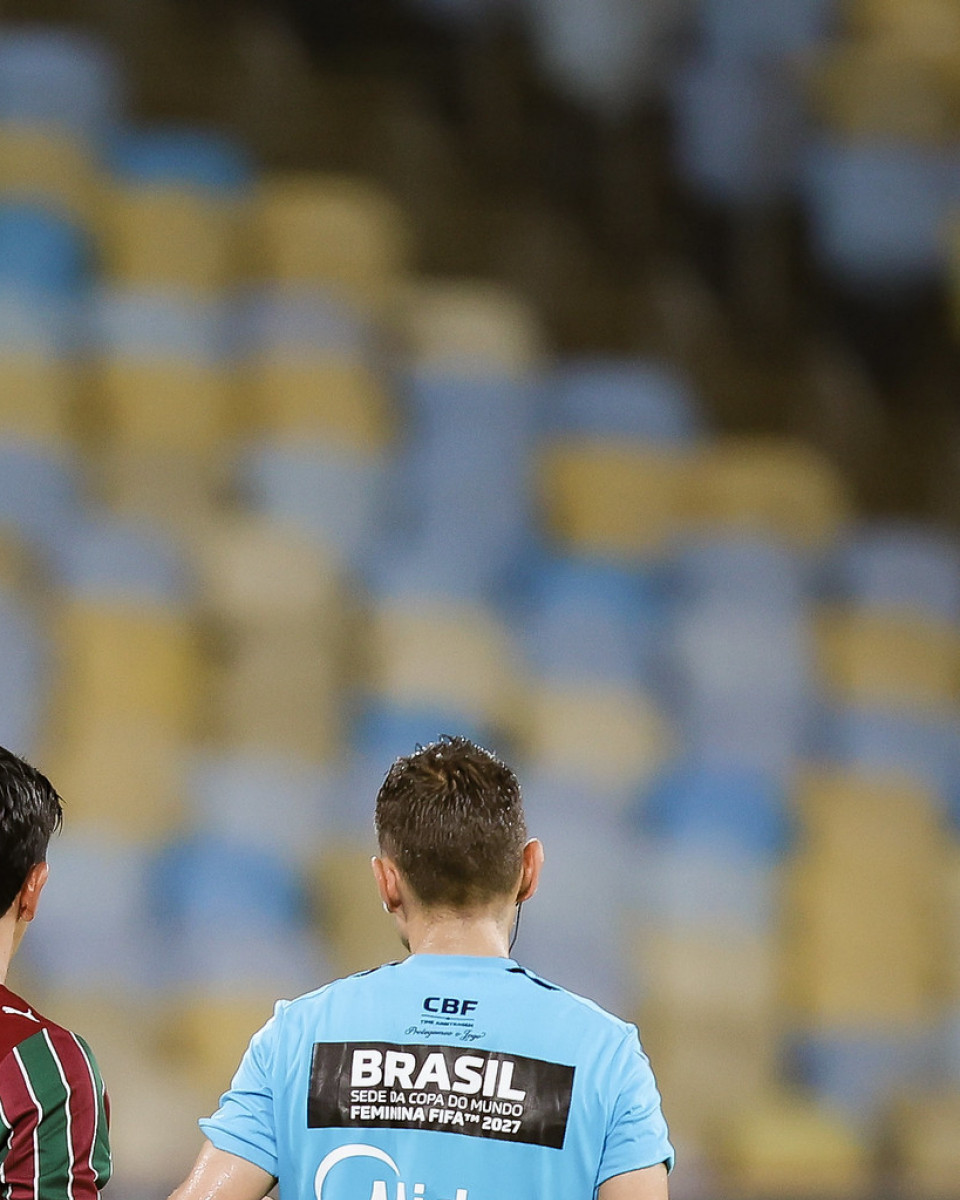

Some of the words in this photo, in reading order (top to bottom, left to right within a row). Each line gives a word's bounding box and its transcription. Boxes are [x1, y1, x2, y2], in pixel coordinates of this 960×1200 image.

[423, 996, 479, 1016] CBF
[350, 1049, 526, 1101] BRASIL
[351, 1089, 386, 1103] SEDE
[390, 1090, 405, 1105] DA
[408, 1091, 444, 1107] COPA
[448, 1095, 468, 1110] DO
[471, 1099, 524, 1118] MUNDO
[350, 1104, 426, 1123] FEMININA
[482, 1116, 521, 1134] 2027
